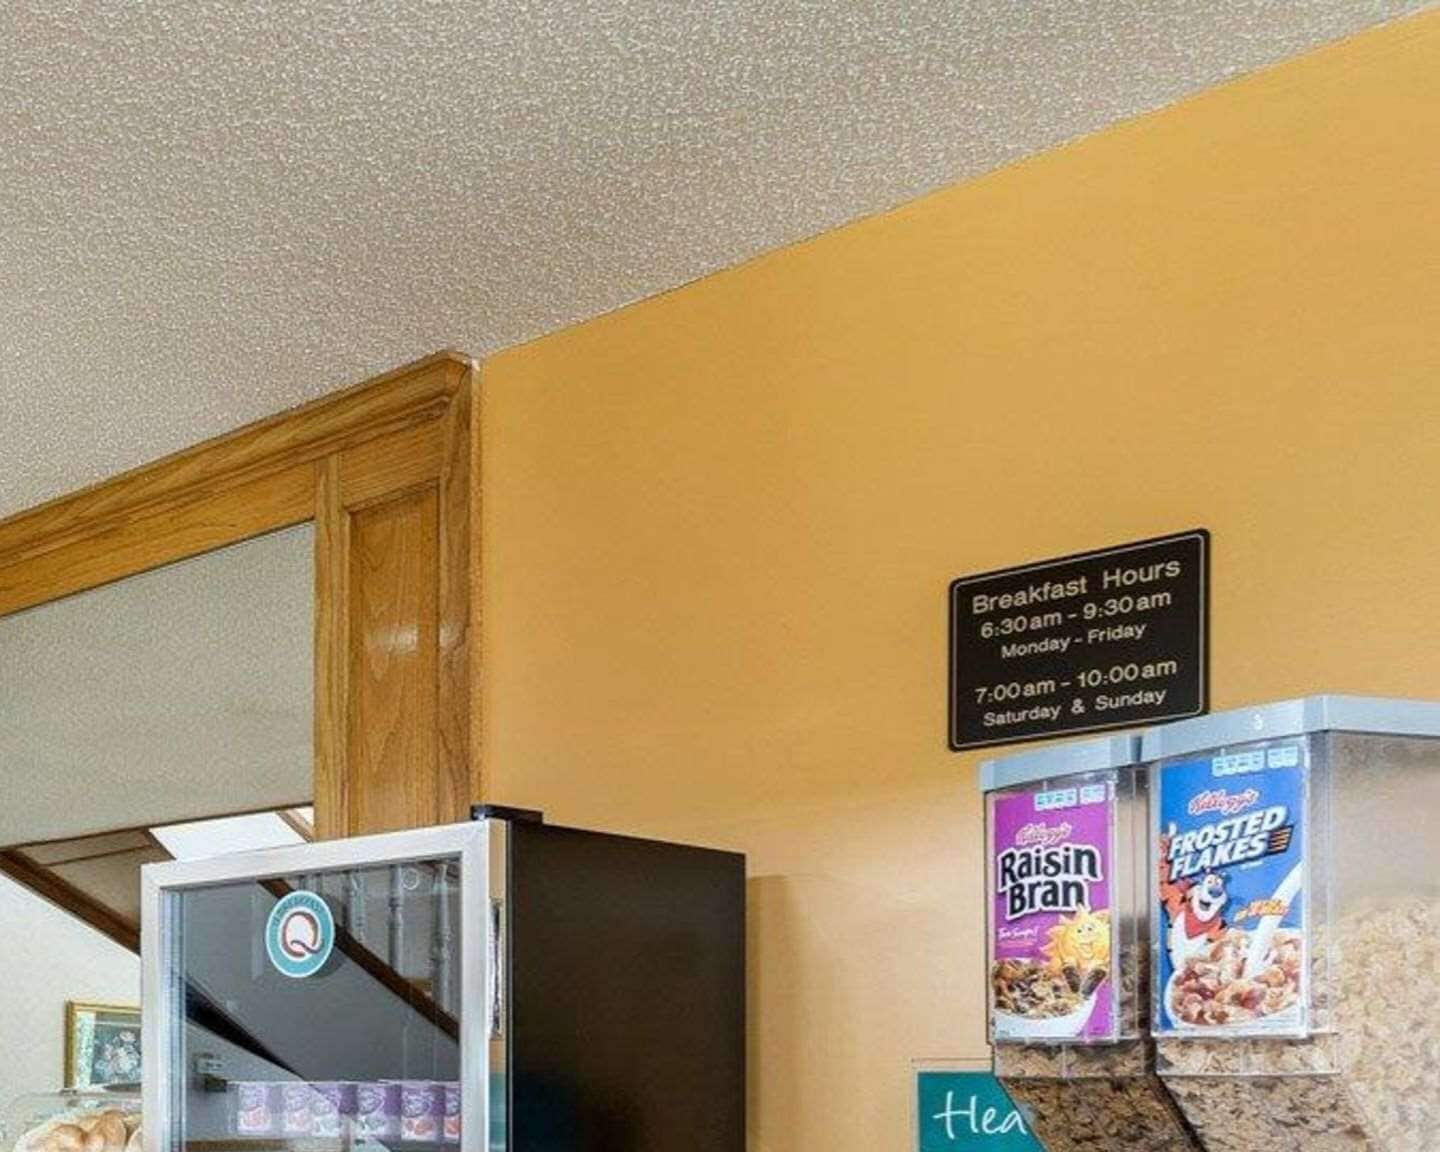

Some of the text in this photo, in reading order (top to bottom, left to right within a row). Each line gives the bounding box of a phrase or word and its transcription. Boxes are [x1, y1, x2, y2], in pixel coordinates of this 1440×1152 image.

[972, 559, 1181, 615] Breakfast Hours
[1001, 636, 1071, 659] Monday
[1087, 623, 1147, 644] Friday
[983, 689, 1167, 727] Saturday & Sunday
[1168, 805, 1288, 860] FROSTED
[1000, 846, 1098, 888] Raisin
[1169, 832, 1269, 882] FLAKES
[1009, 879, 1085, 916] Bran
[932, 1090, 1028, 1140] Hea
